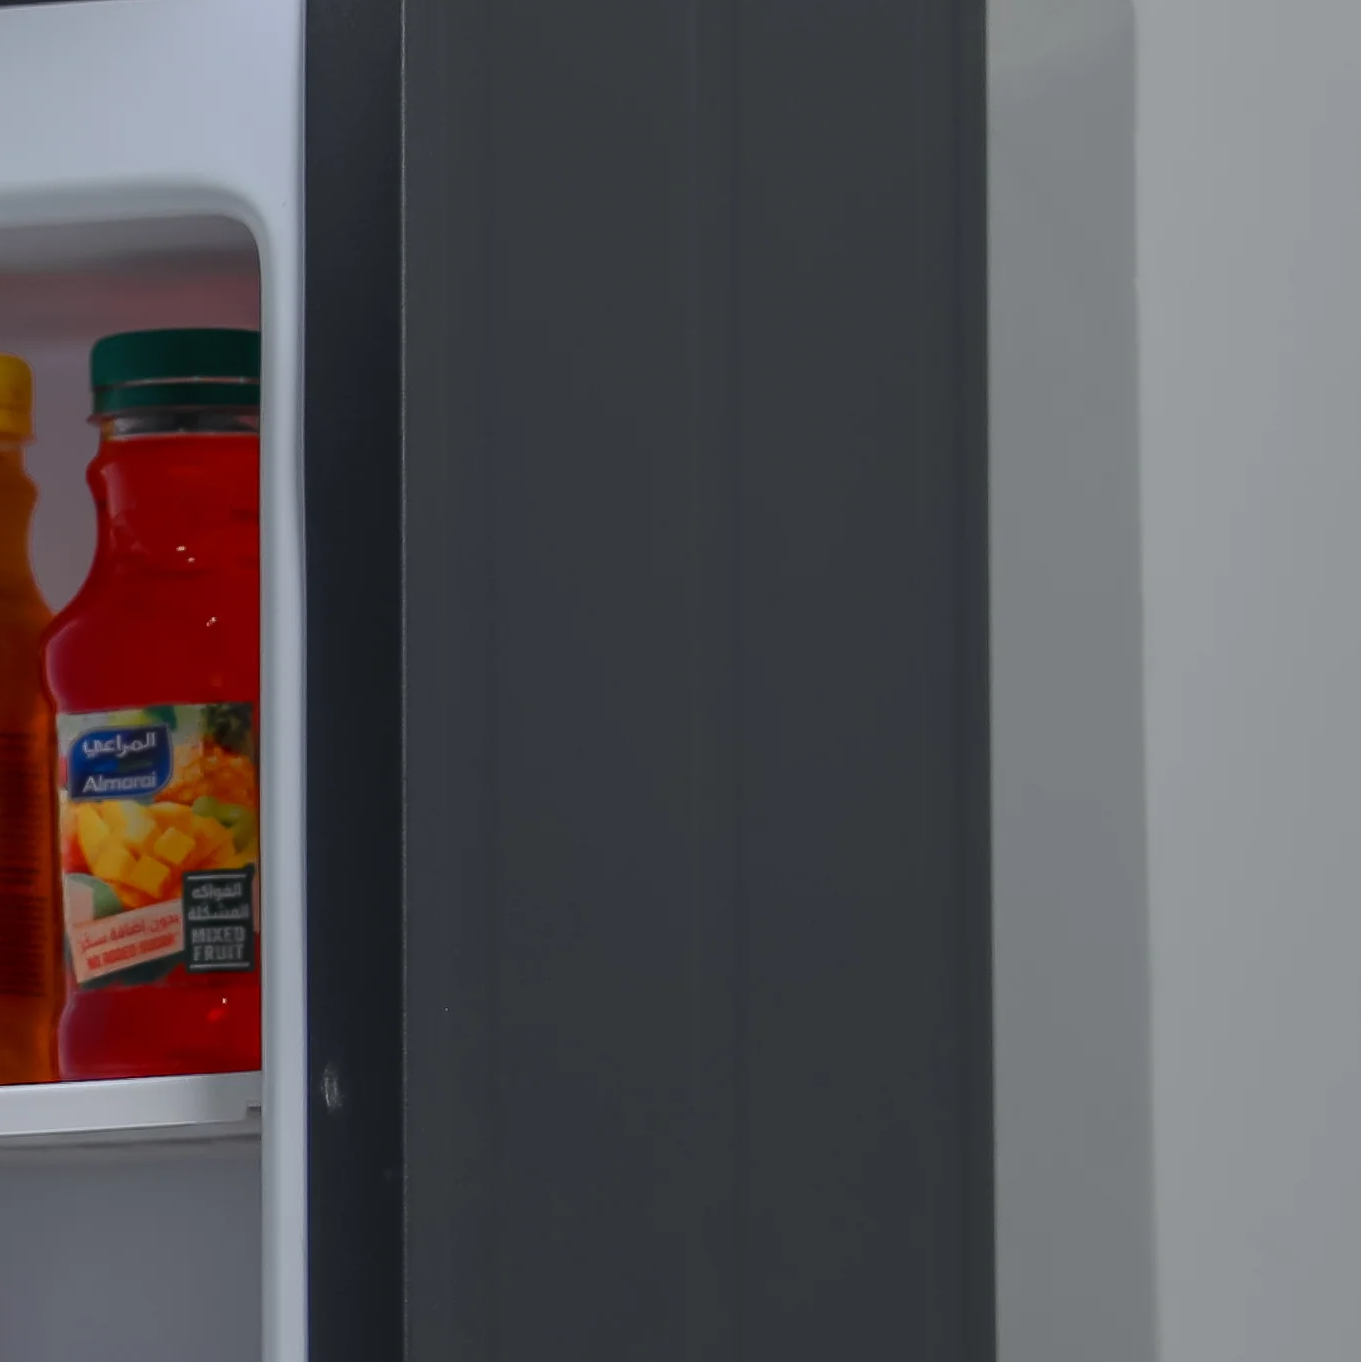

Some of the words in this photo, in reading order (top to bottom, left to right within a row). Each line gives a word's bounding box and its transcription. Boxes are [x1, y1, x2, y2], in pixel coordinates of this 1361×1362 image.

[81, 730, 157, 759] المراعي
[81, 770, 158, 794] Almarai
[191, 925, 247, 945] MIXED
[193, 944, 245, 962] FRUIT
